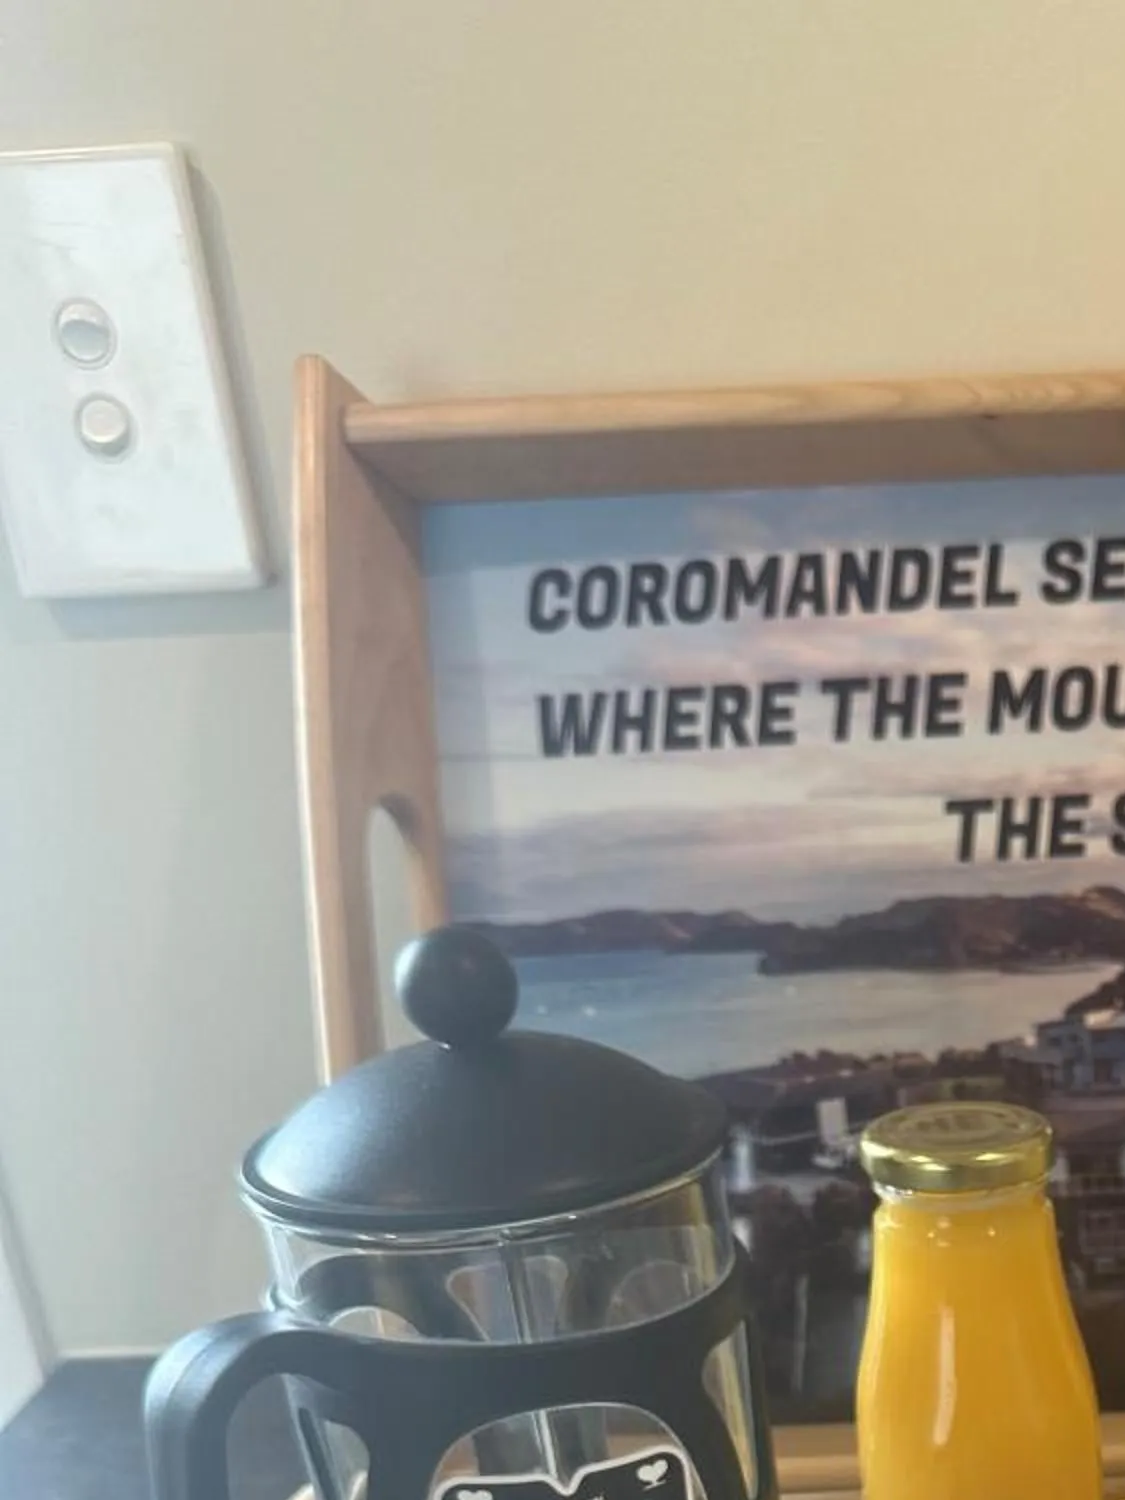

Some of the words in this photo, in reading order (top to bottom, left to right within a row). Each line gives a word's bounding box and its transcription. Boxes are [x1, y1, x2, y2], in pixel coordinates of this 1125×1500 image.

[527, 544, 1018, 634] COROMANDEL
[535, 681, 798, 759] WHERE
[820, 671, 966, 742] THE
[945, 792, 1091, 863] THE
